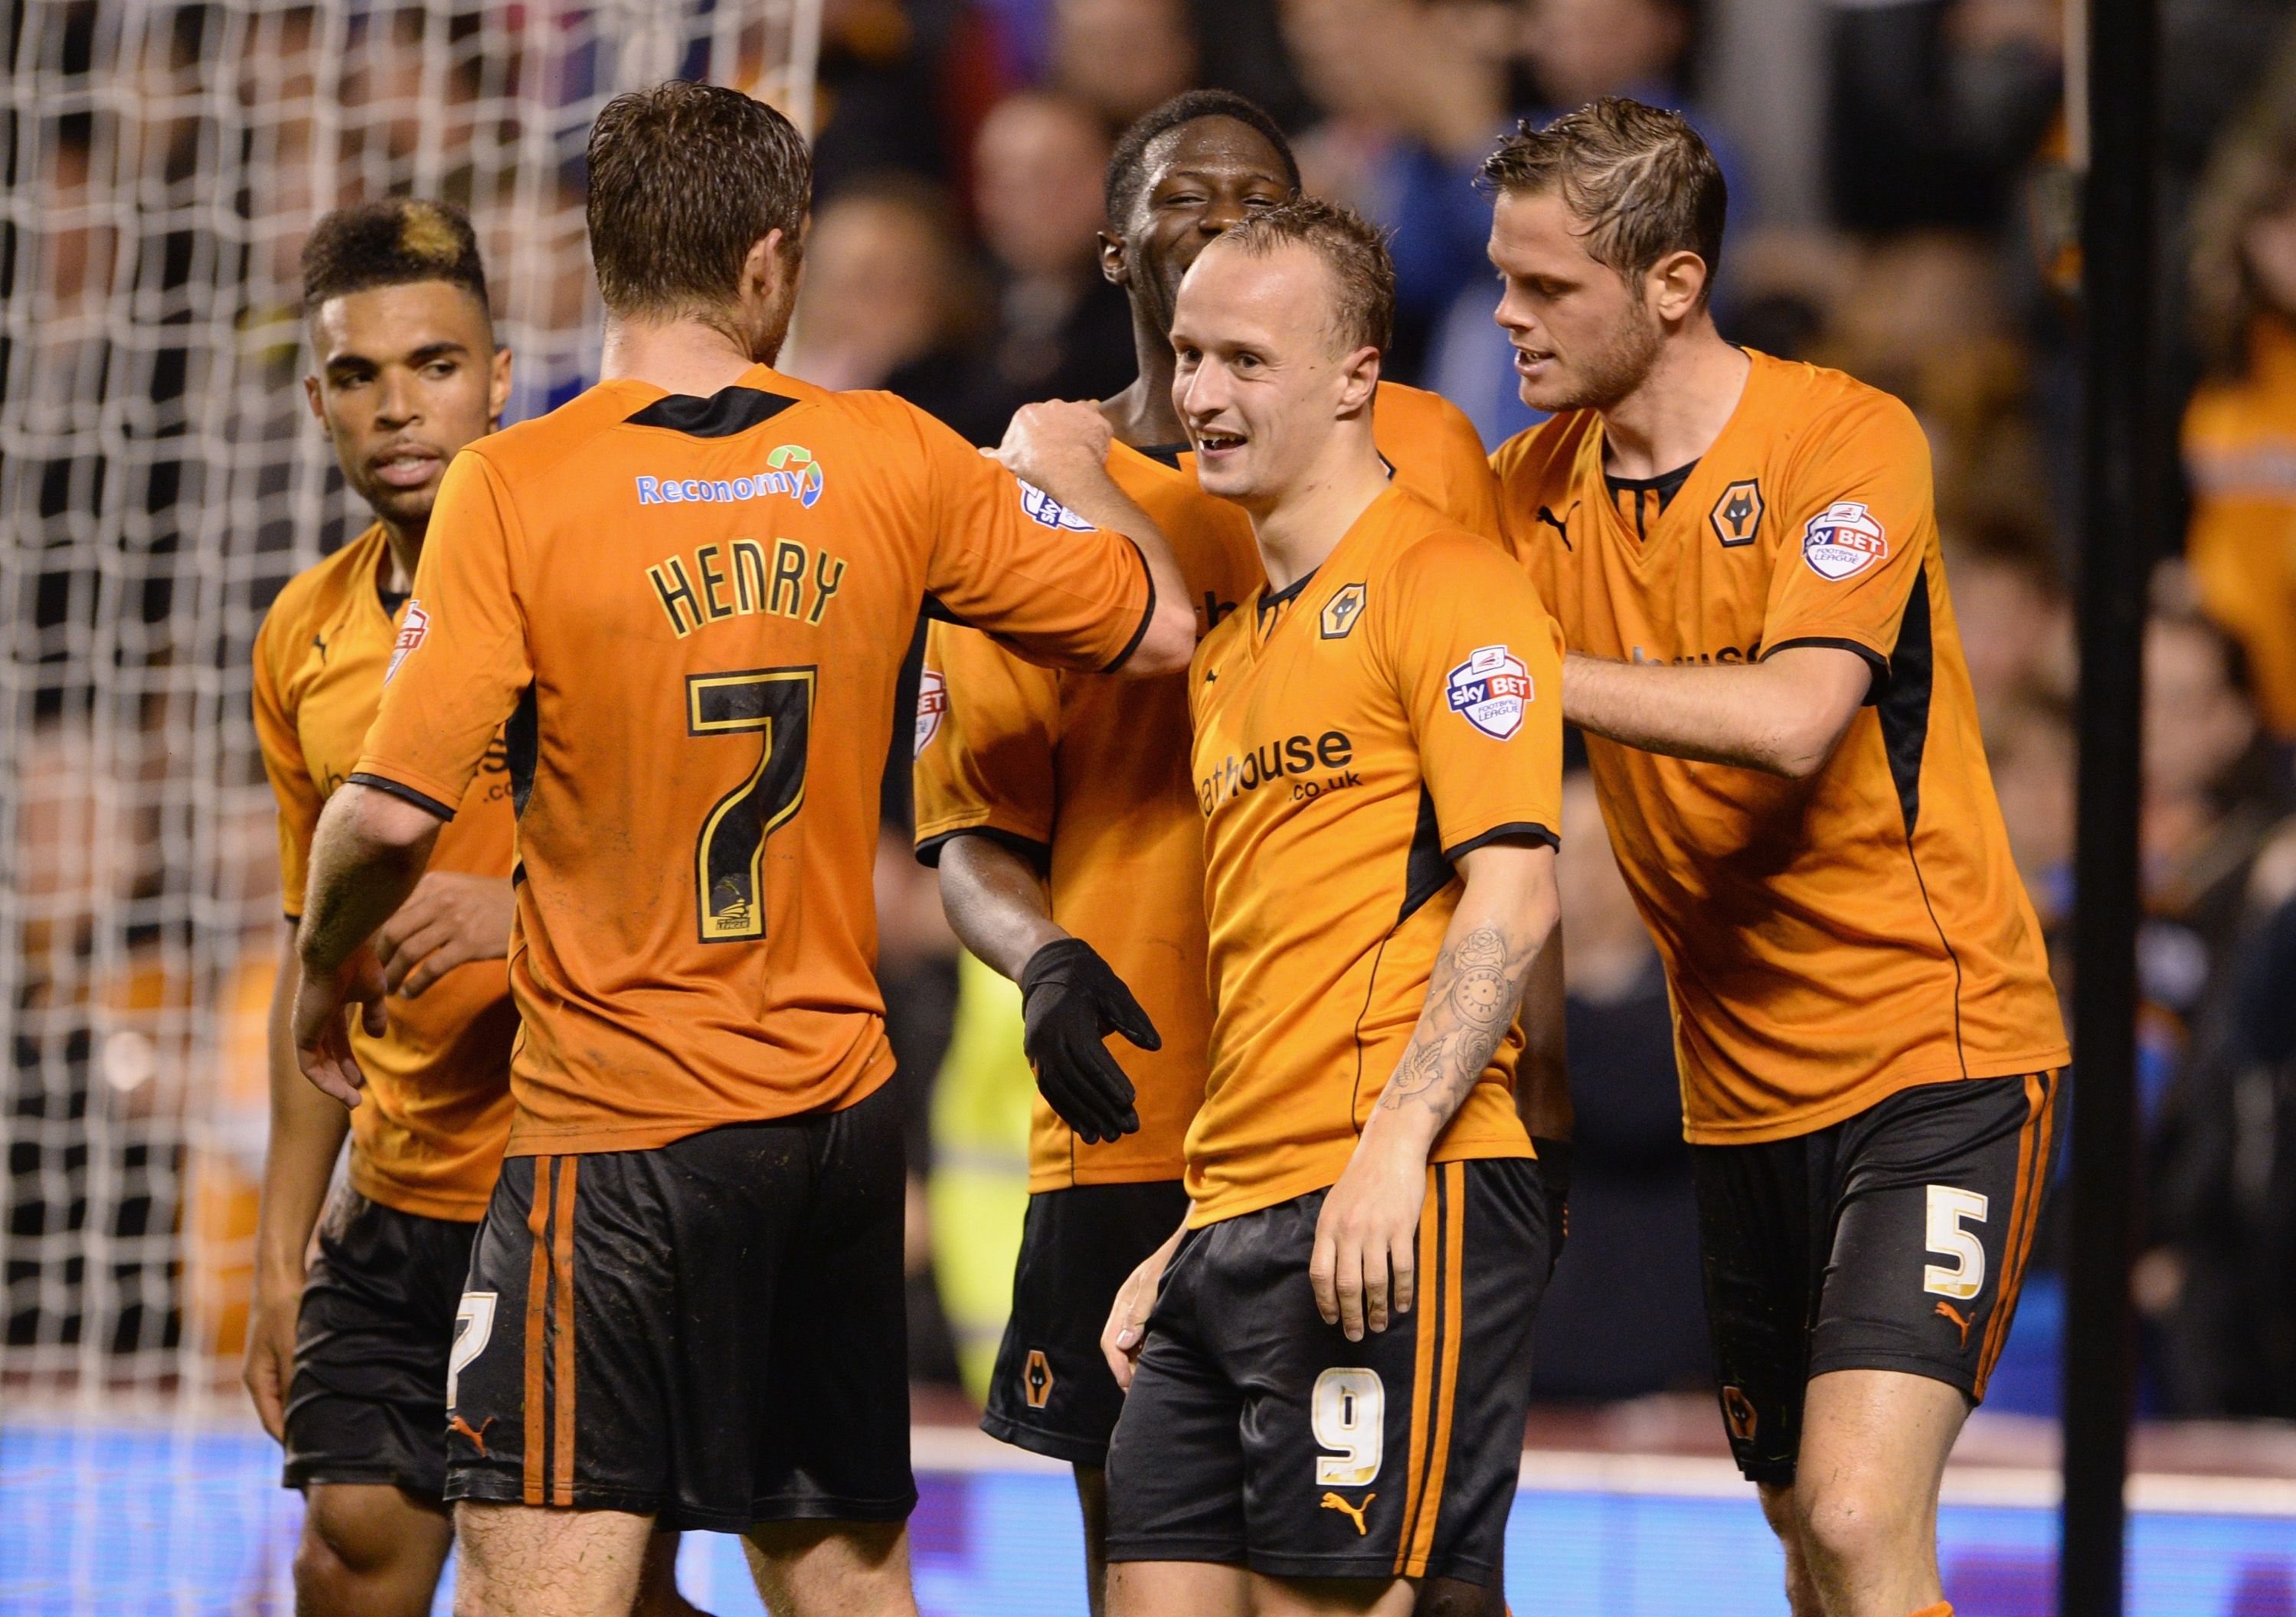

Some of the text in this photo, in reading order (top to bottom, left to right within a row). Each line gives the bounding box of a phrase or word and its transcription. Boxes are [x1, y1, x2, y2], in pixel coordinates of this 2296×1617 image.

[636, 469, 806, 505] Reconomy
[1839, 529, 1881, 552] BET
[1814, 554, 1859, 564] LEAGUE
[646, 537, 848, 639] HENRY
[396, 631, 422, 647] ET
[919, 692, 944, 710] ET
[1451, 677, 1527, 705] sky BET
[1478, 705, 1519, 721] LEAGUE
[1198, 730, 1352, 817] athouse
[1289, 771, 1362, 802] .co.uk
[685, 665, 817, 943] 7
[1924, 1184, 1988, 1300] 5
[446, 1291, 498, 1410] 7
[1311, 1367, 1385, 1486] 9
